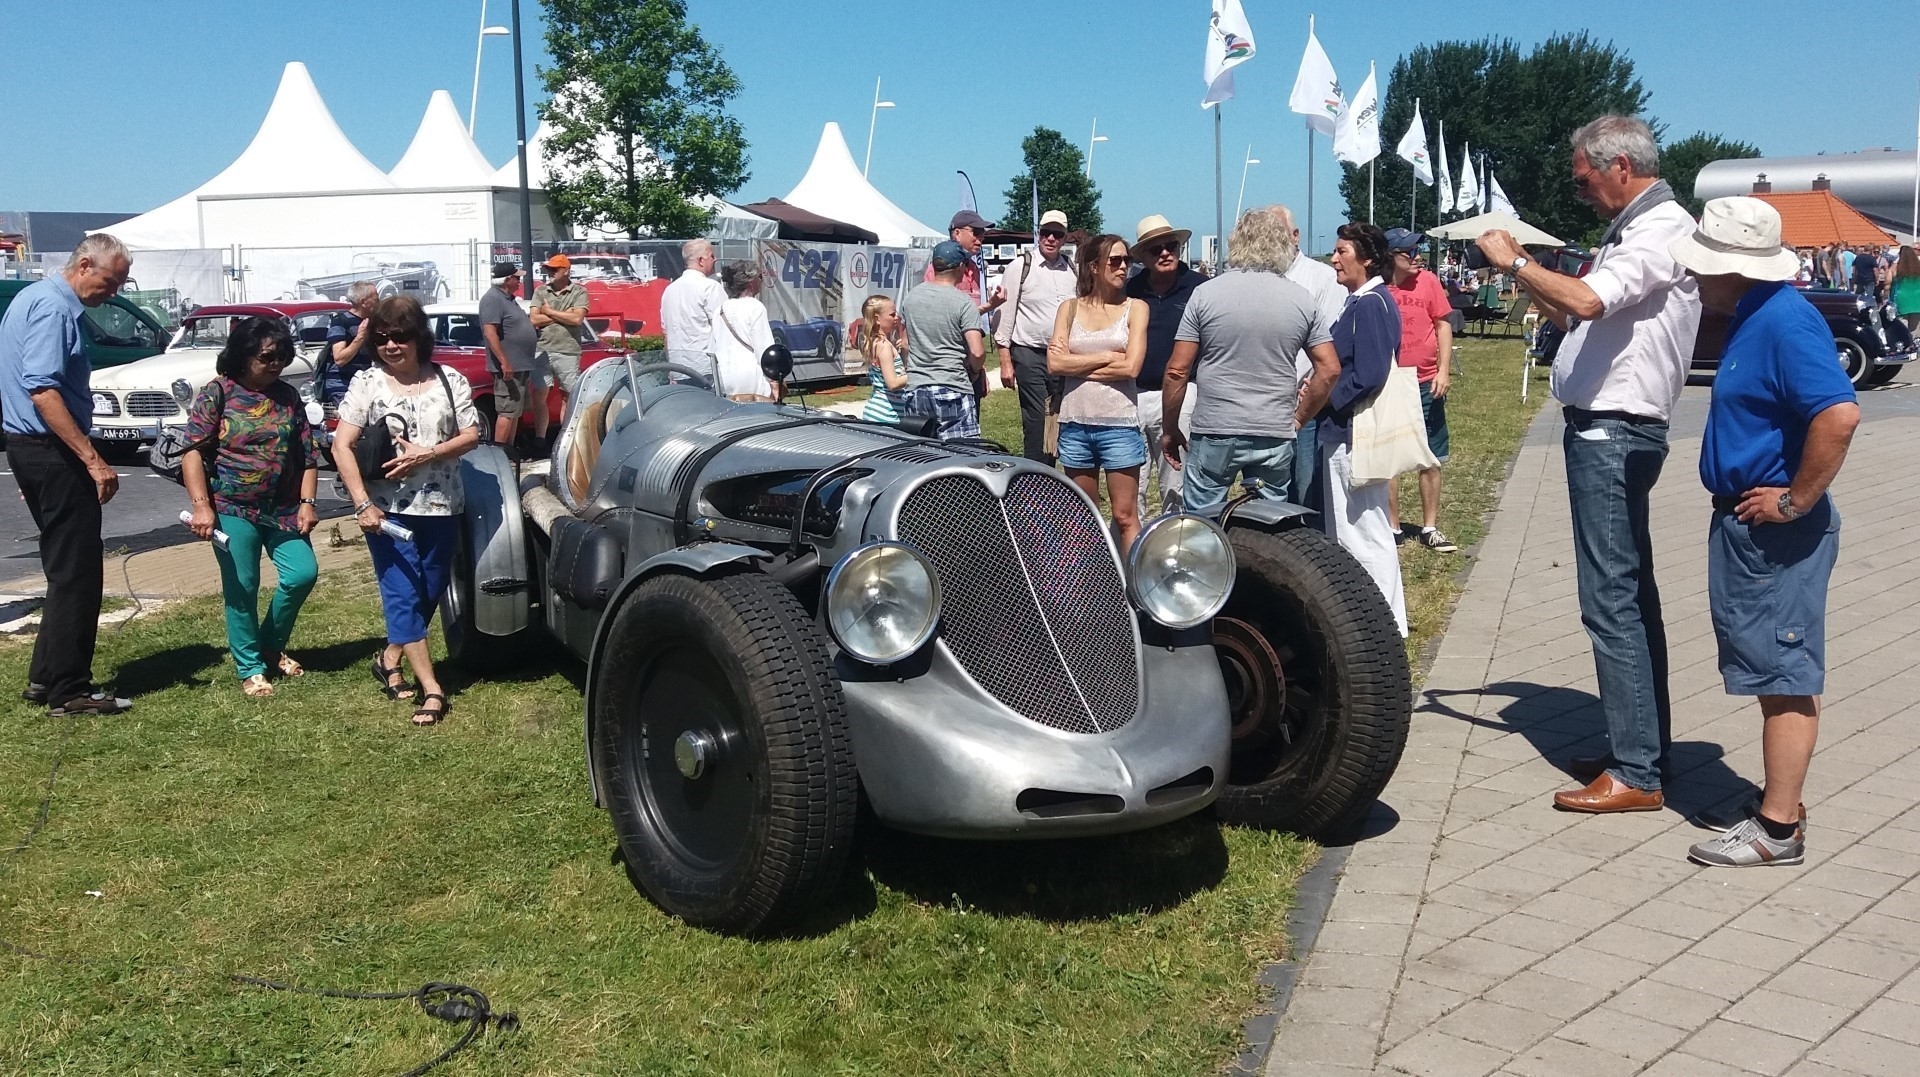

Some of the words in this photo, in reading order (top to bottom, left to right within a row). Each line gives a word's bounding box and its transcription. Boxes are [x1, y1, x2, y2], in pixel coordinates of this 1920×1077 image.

[493, 254, 522, 263] OLDTIMER
[782, 248, 838, 288] 427
[871, 252, 905, 288] 427
[103, 429, 140, 439] AM-69-51
